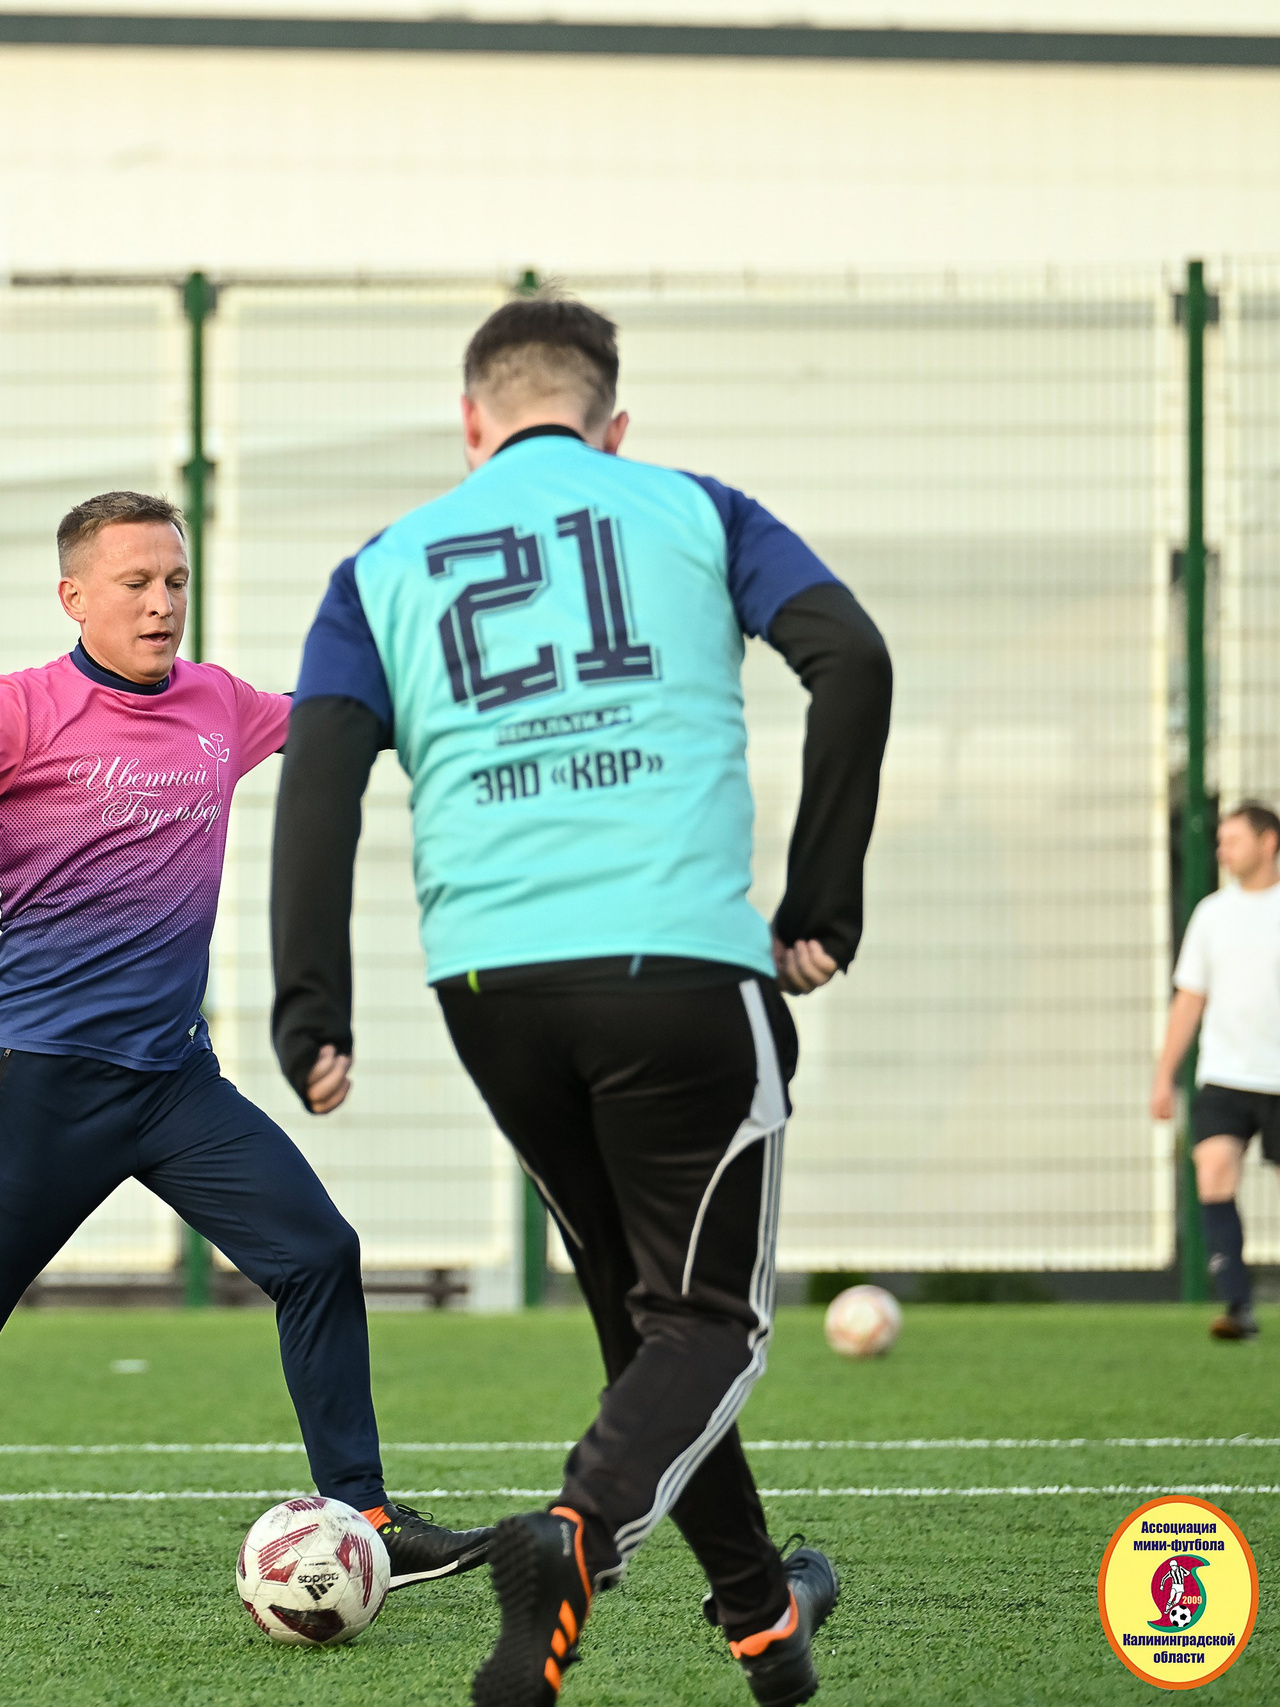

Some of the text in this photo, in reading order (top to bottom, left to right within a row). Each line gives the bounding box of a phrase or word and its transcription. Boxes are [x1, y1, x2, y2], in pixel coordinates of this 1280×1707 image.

[424, 504, 662, 714] 21
[67, 754, 208, 802] Цветной
[471, 748, 663, 805] ЗАО «КВР»
[102, 789, 222, 839] Бульвар
